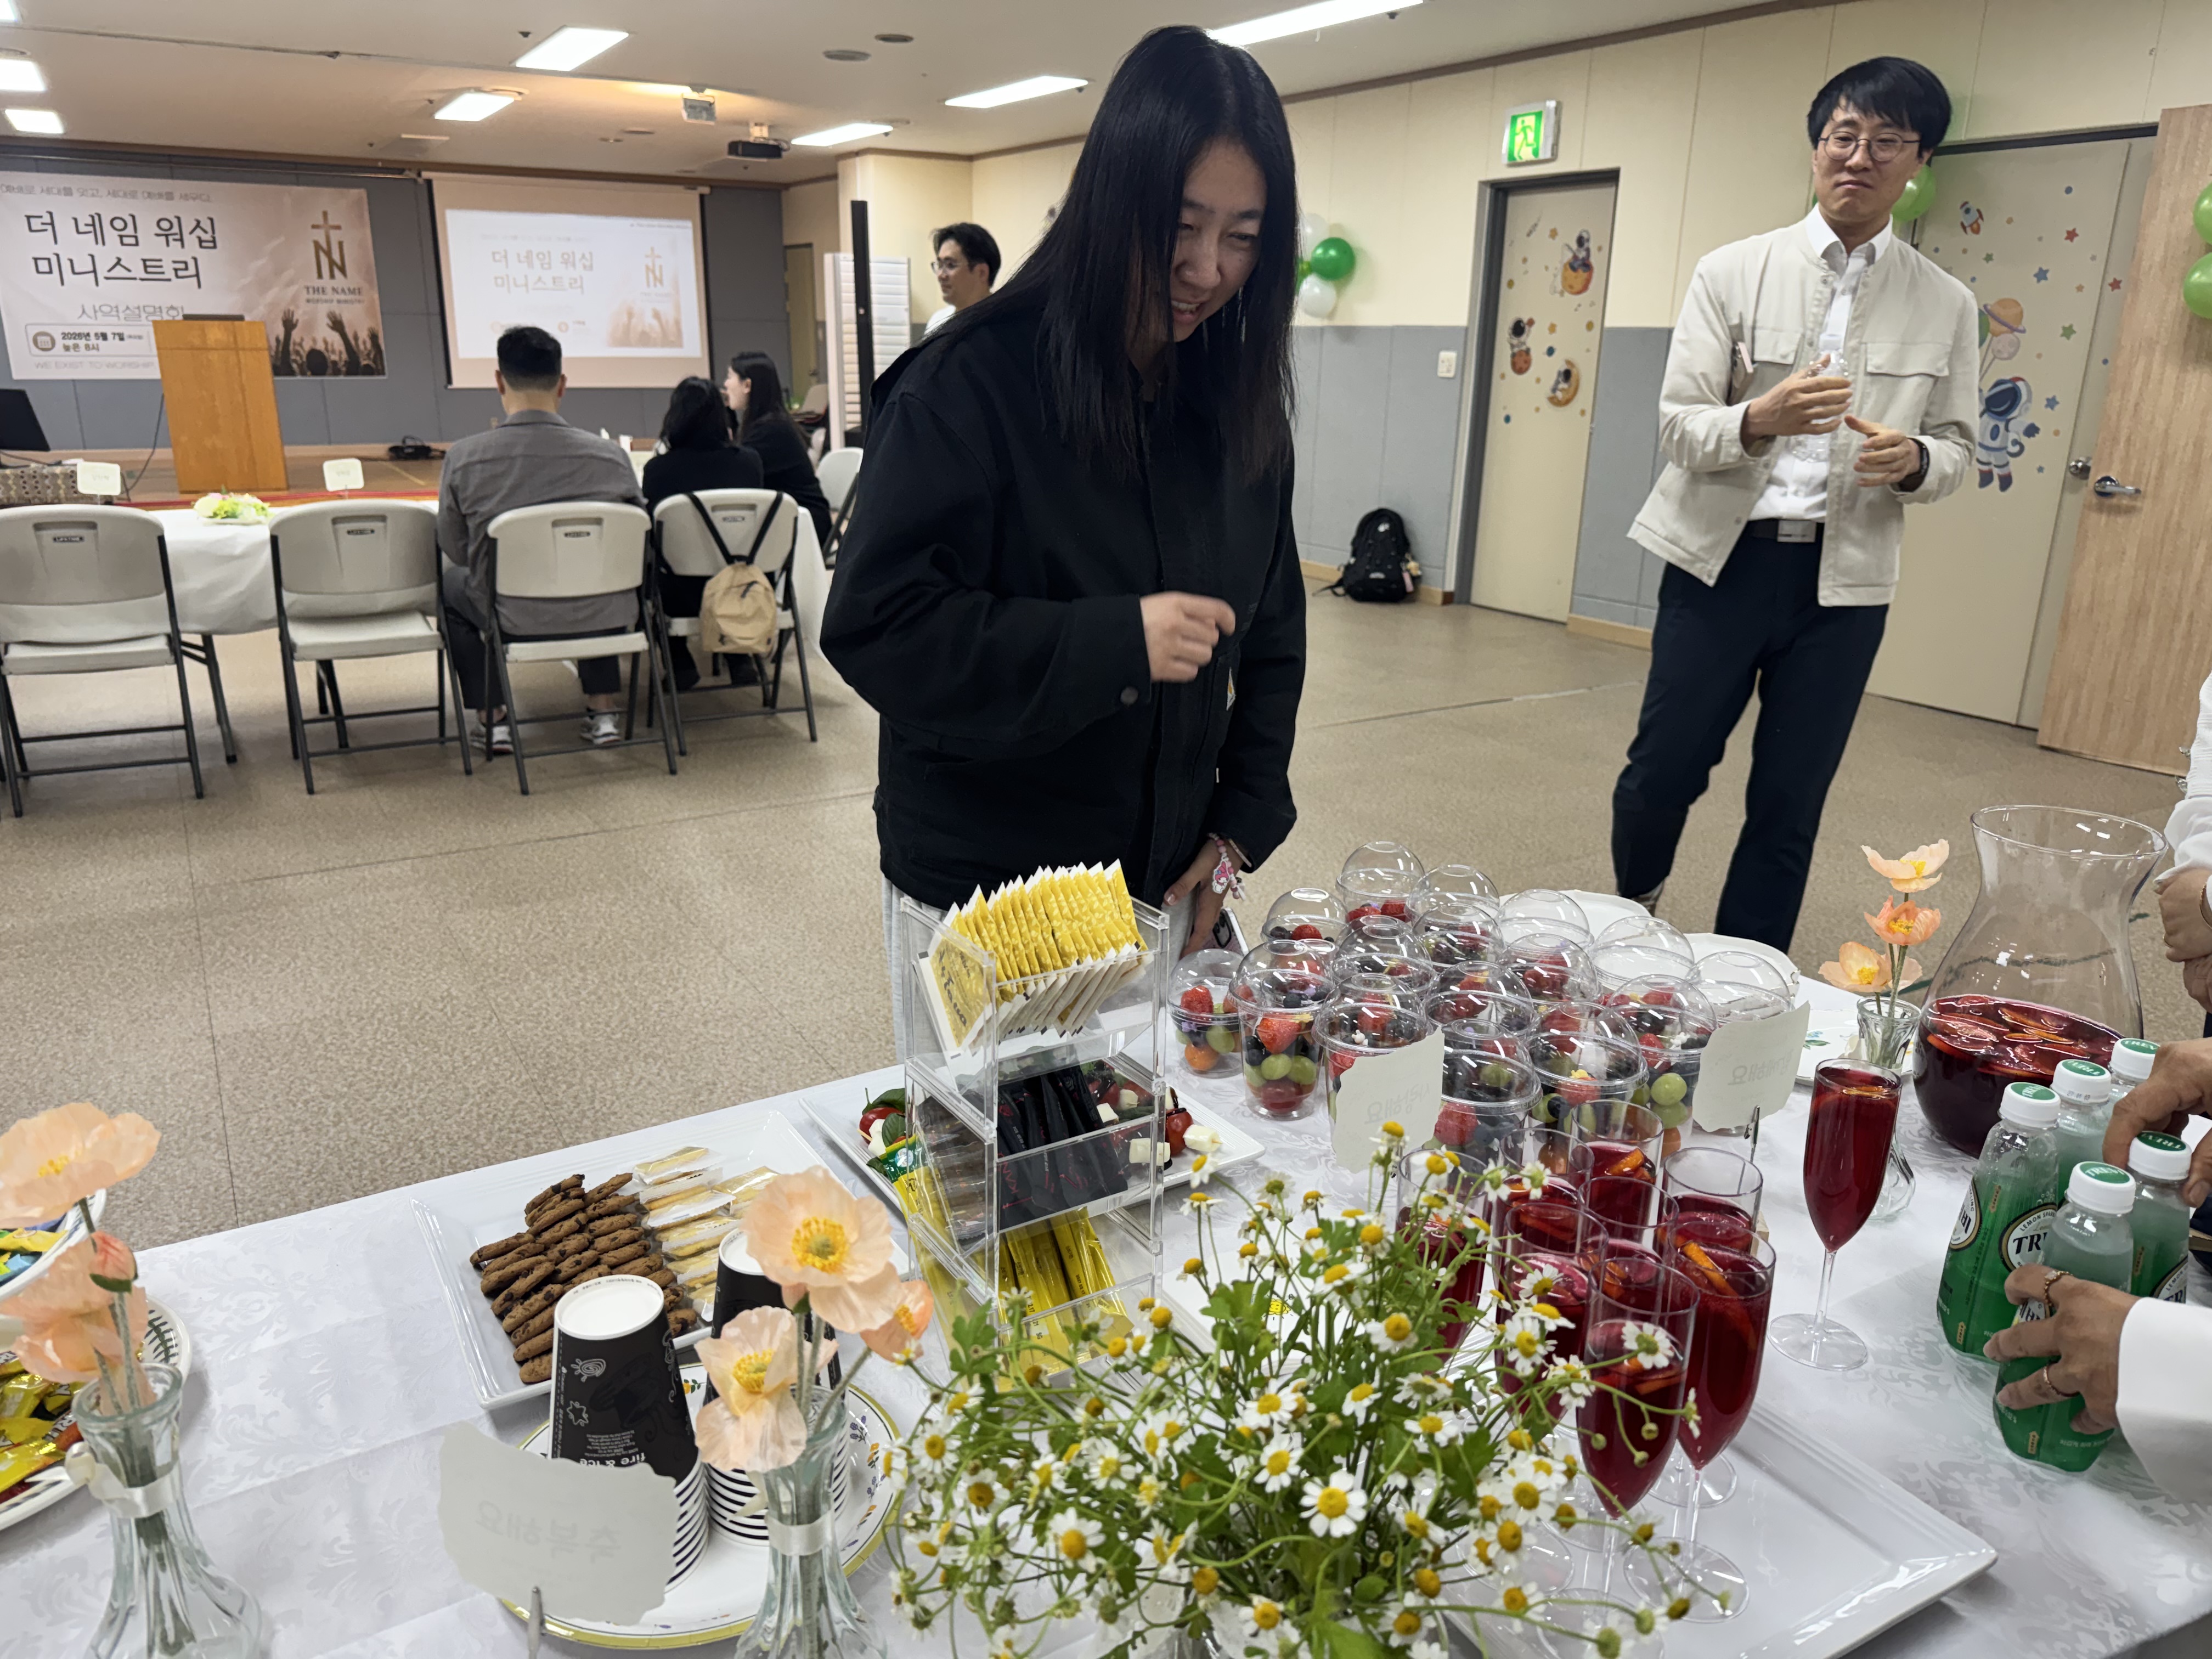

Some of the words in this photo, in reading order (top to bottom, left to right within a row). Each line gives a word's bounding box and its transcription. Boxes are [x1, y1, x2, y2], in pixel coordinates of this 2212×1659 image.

[25, 211, 58, 245] 더
[72, 212, 139, 247] 네임
[154, 216, 218, 249] 워십
[491, 249, 509, 269] 더
[516, 249, 552, 271] 네임
[560, 250, 594, 272] 워십
[32, 252, 202, 289] 미니스트리
[304, 285, 328, 295] THE
[493, 273, 585, 295] 미니스트리
[61, 332, 92, 341] 2026년
[94, 332, 108, 341] 5월
[111, 332, 126, 341] 7일
[2020, 1215, 2041, 1232] LEMON
[605, 1459, 616, 1469] &
[620, 1452, 646, 1465] fire
